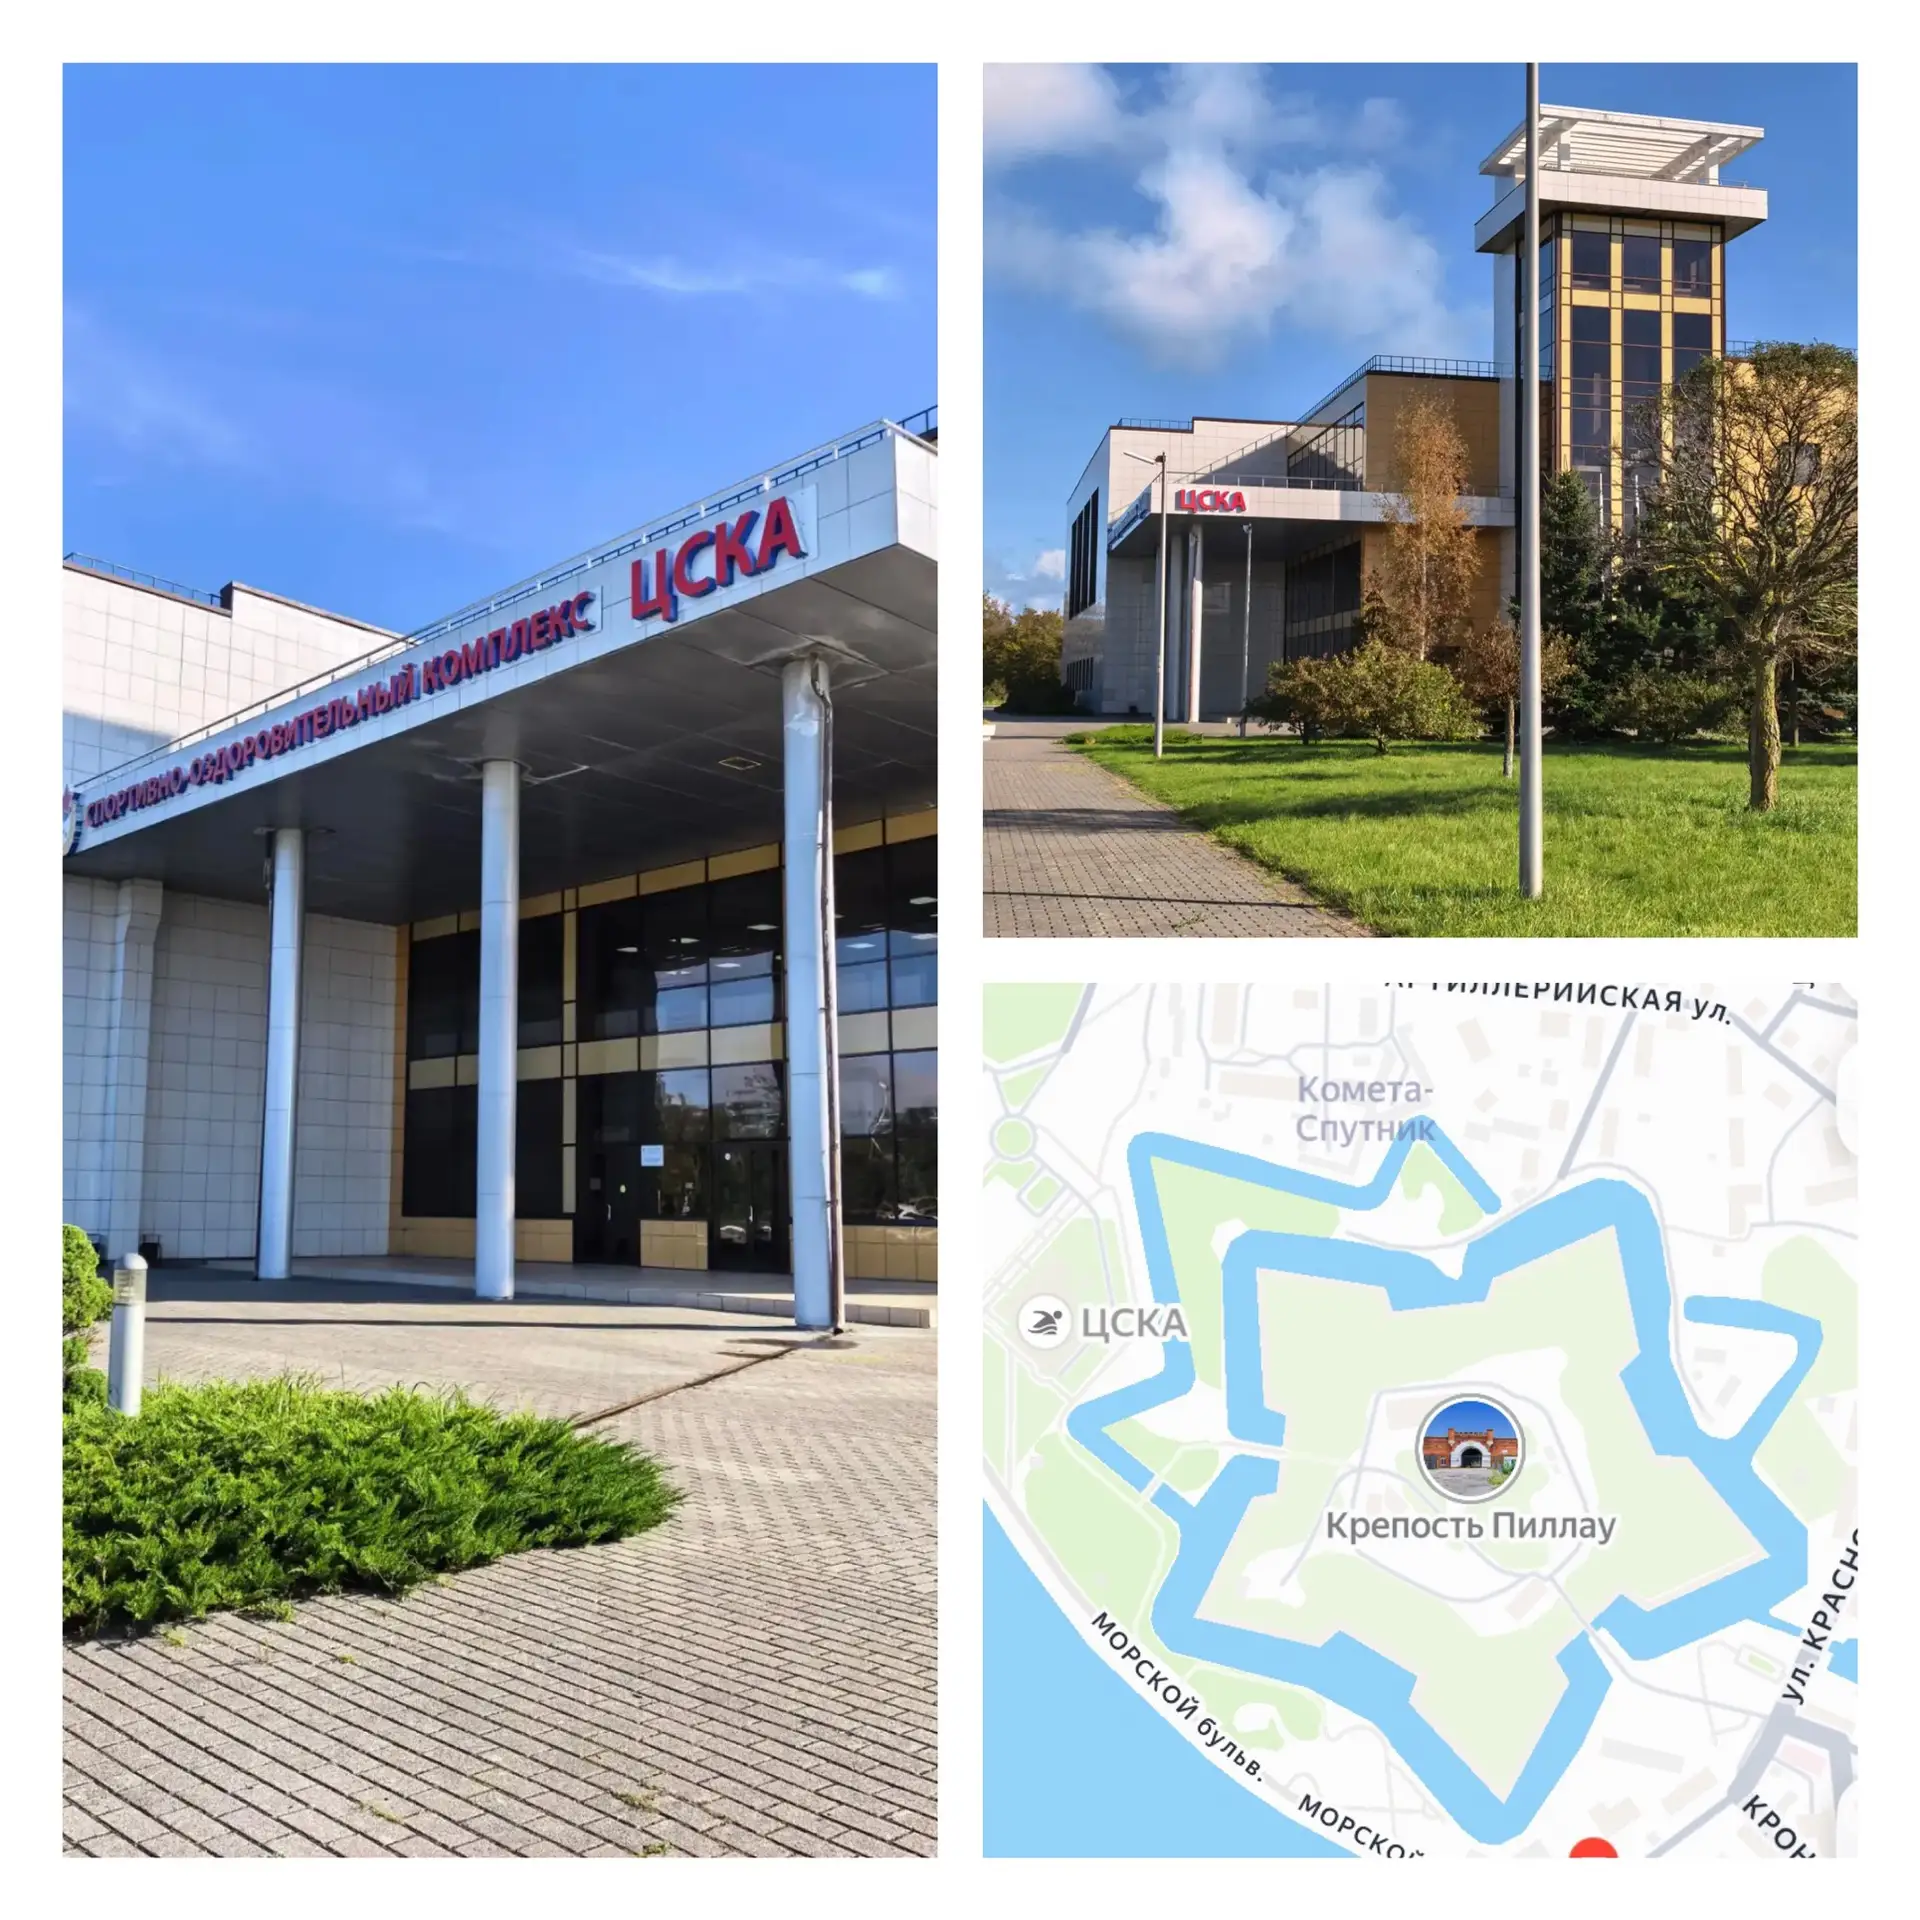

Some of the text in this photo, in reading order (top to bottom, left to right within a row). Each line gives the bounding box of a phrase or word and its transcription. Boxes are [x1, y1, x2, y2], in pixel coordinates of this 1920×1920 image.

[1177, 488, 1247, 514] ЦСКА
[84, 496, 804, 829] СПОРТИВНО-ОЗДОРОВИТЕЛЬНЫЙ КОМПЛЕКС ЦСКА
[1691, 998, 1731, 1026] ул.
[1298, 1076, 1434, 1103] Комета-
[1296, 1114, 1436, 1148] Спутник
[1081, 1308, 1188, 1343] ЦСКА
[1326, 1512, 1617, 1545] Крепость Пиллау
[1091, 1611, 1263, 1783] МОРСКОЙ бульв.
[1781, 1661, 1816, 1706] ул.
[1297, 1793, 1425, 1858] МОРСКО
